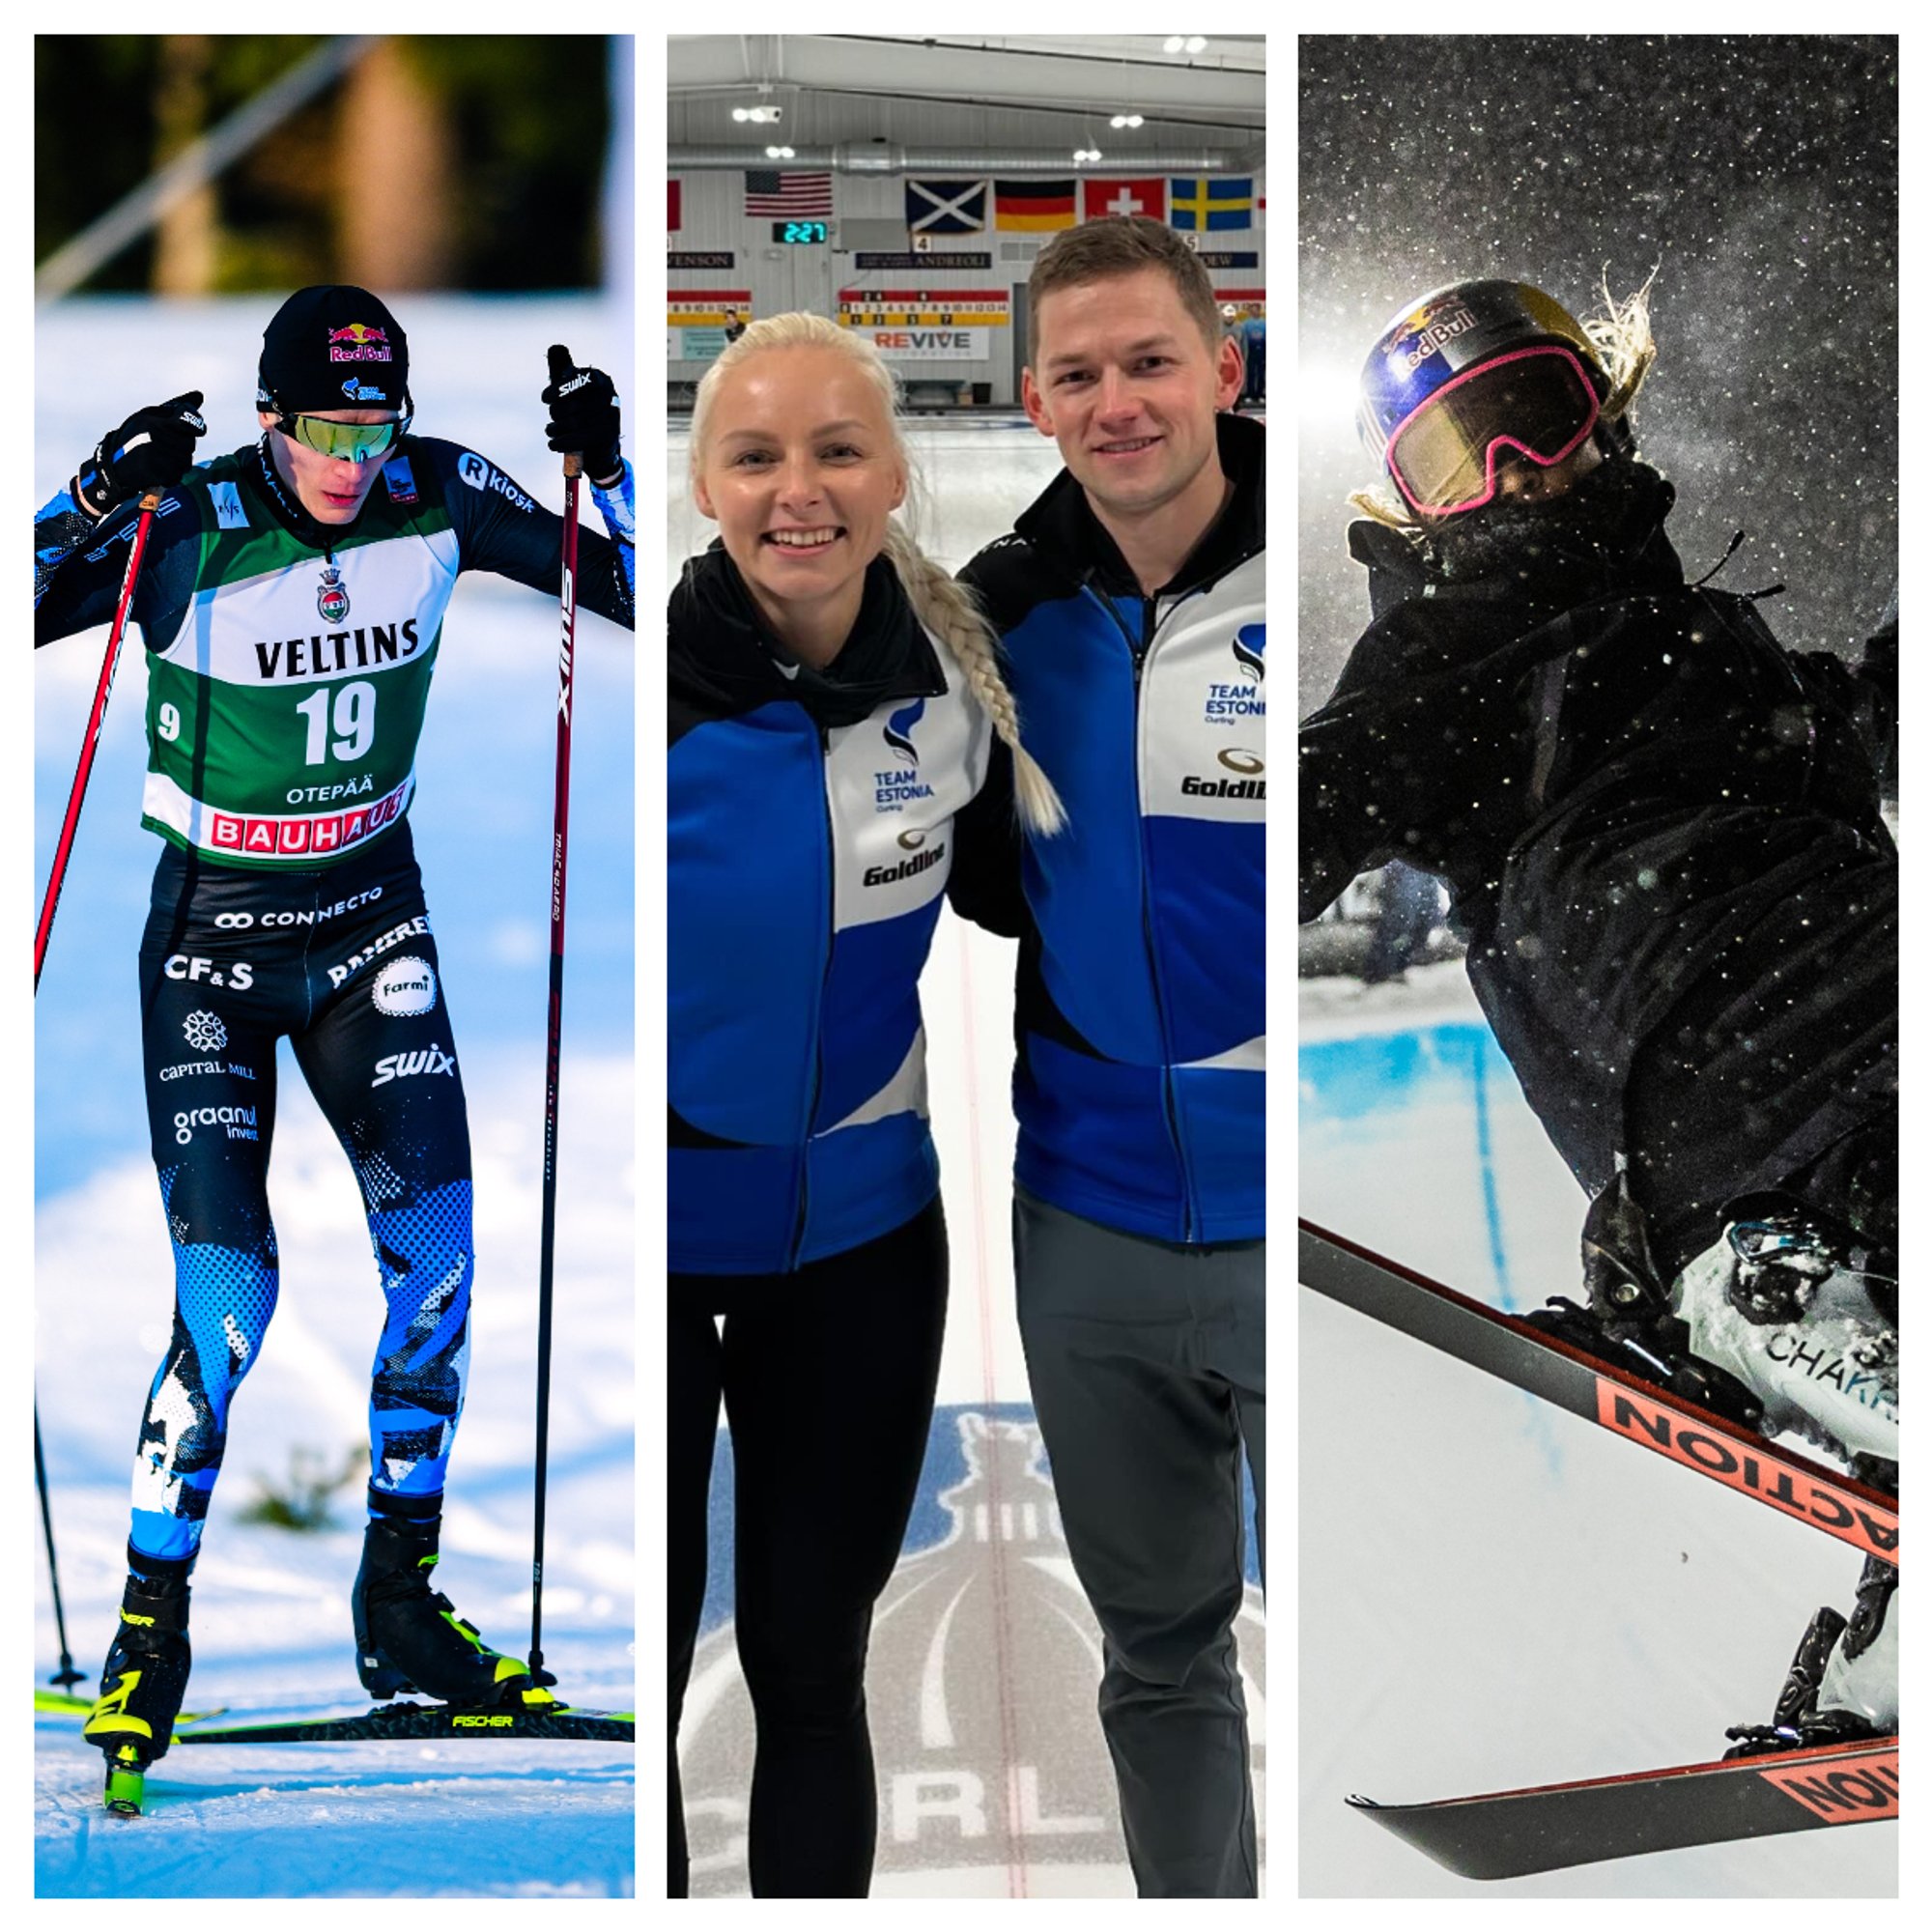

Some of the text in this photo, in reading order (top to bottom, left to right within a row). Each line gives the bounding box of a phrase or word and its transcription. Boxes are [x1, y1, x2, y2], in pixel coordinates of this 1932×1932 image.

[918, 238, 927, 250] 4
[874, 331, 971, 349] REVIVE
[1430, 308, 1478, 349] Bull
[329, 345, 392, 362] Red Bull
[489, 469, 536, 514] kiosk
[254, 618, 419, 679] VELTINS
[1208, 683, 1257, 698] TEAM
[296, 680, 377, 766] 19
[286, 774, 374, 805] OTEPÄÄ
[874, 770, 917, 786] TEAM
[875, 783, 935, 803] ESTONIA
[215, 791, 406, 850] BAUHAUS
[260, 887, 383, 927] CONNECTO
[383, 975, 430, 997] Farmi
[228, 1062, 257, 1081] MILL
[173, 1105, 258, 1146] graanul
[1613, 1394, 1898, 1551] ACTION
[451, 1714, 514, 1728] FISCHER
